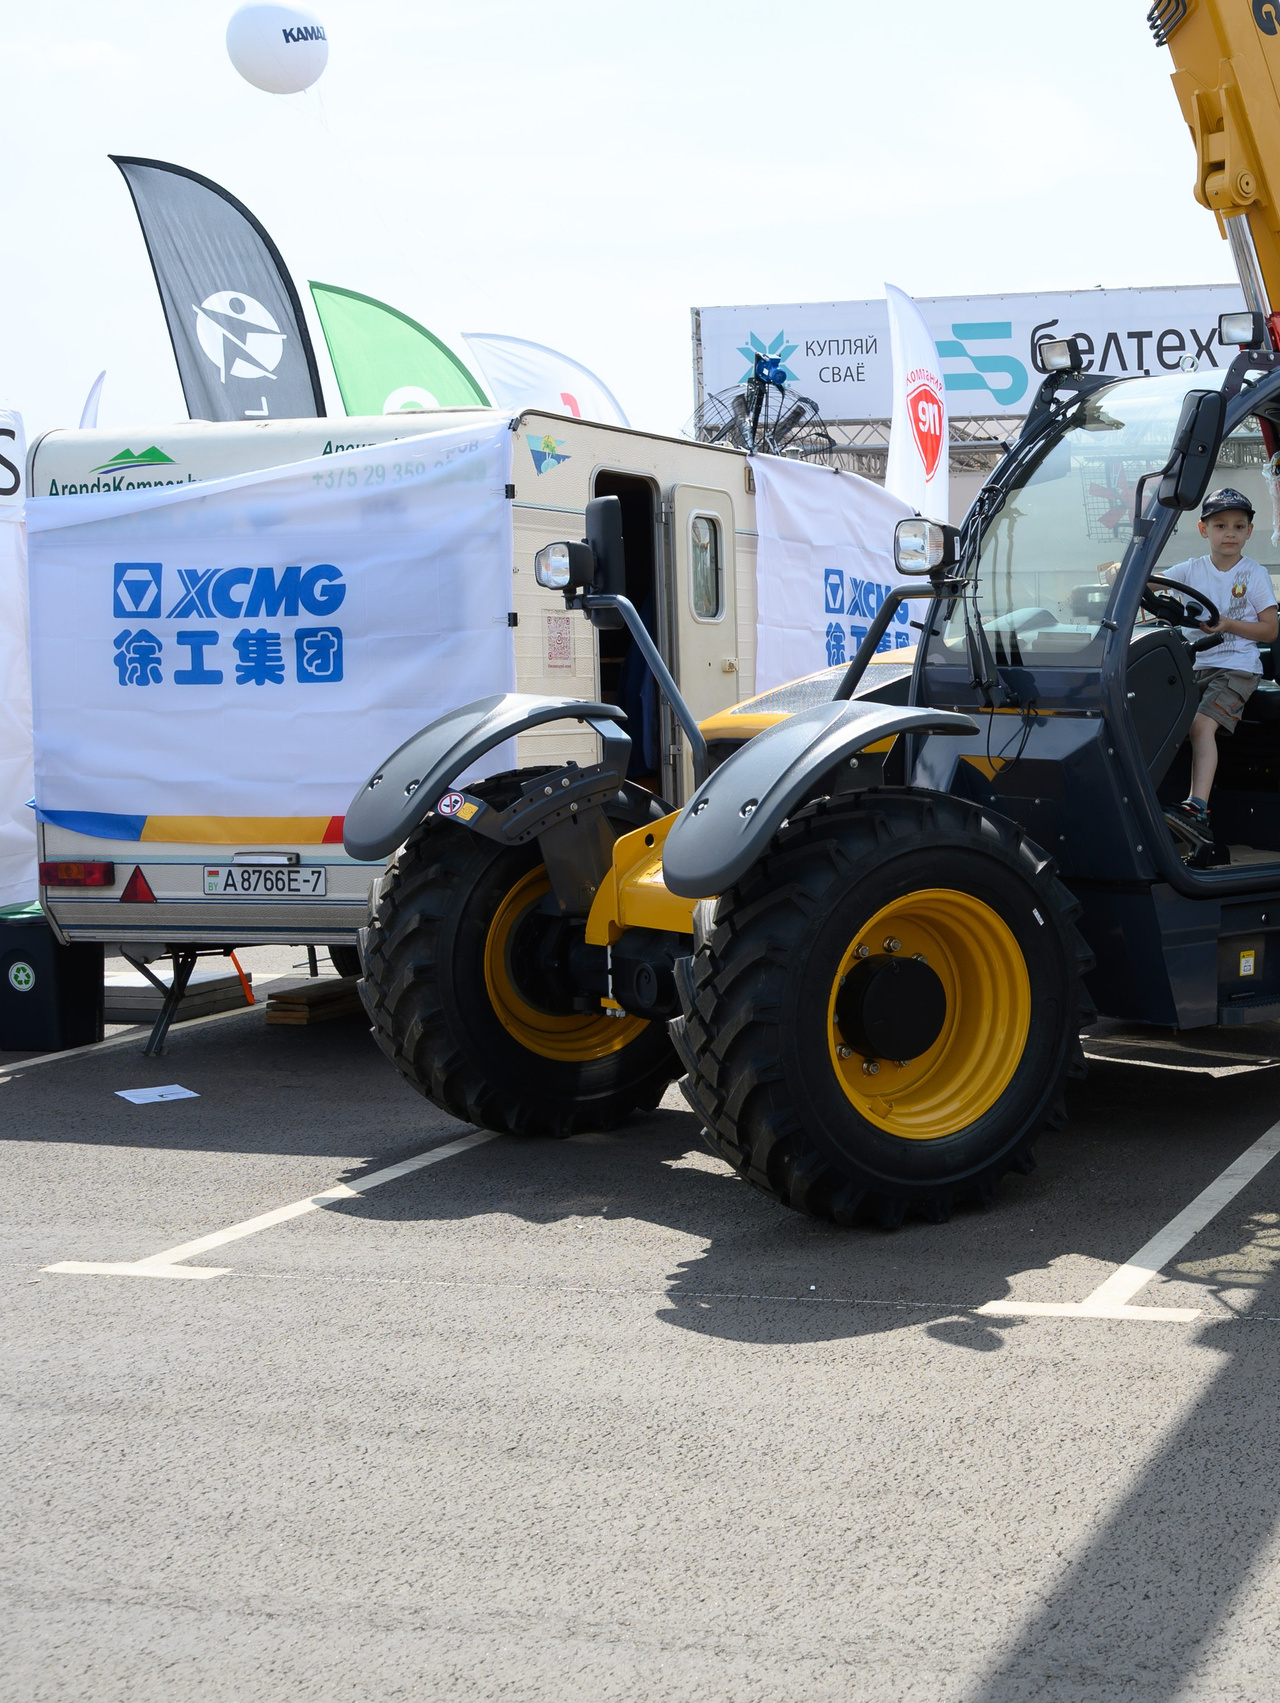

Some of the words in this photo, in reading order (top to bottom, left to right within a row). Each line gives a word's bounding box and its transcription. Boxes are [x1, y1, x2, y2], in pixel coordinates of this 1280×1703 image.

[805, 335, 878, 357] КУПЛЯЙ
[819, 362, 865, 383] СВАЁ
[165, 564, 347, 619] XCMG
[113, 626, 343, 686] 徐工集团
[208, 882, 218, 891] BY
